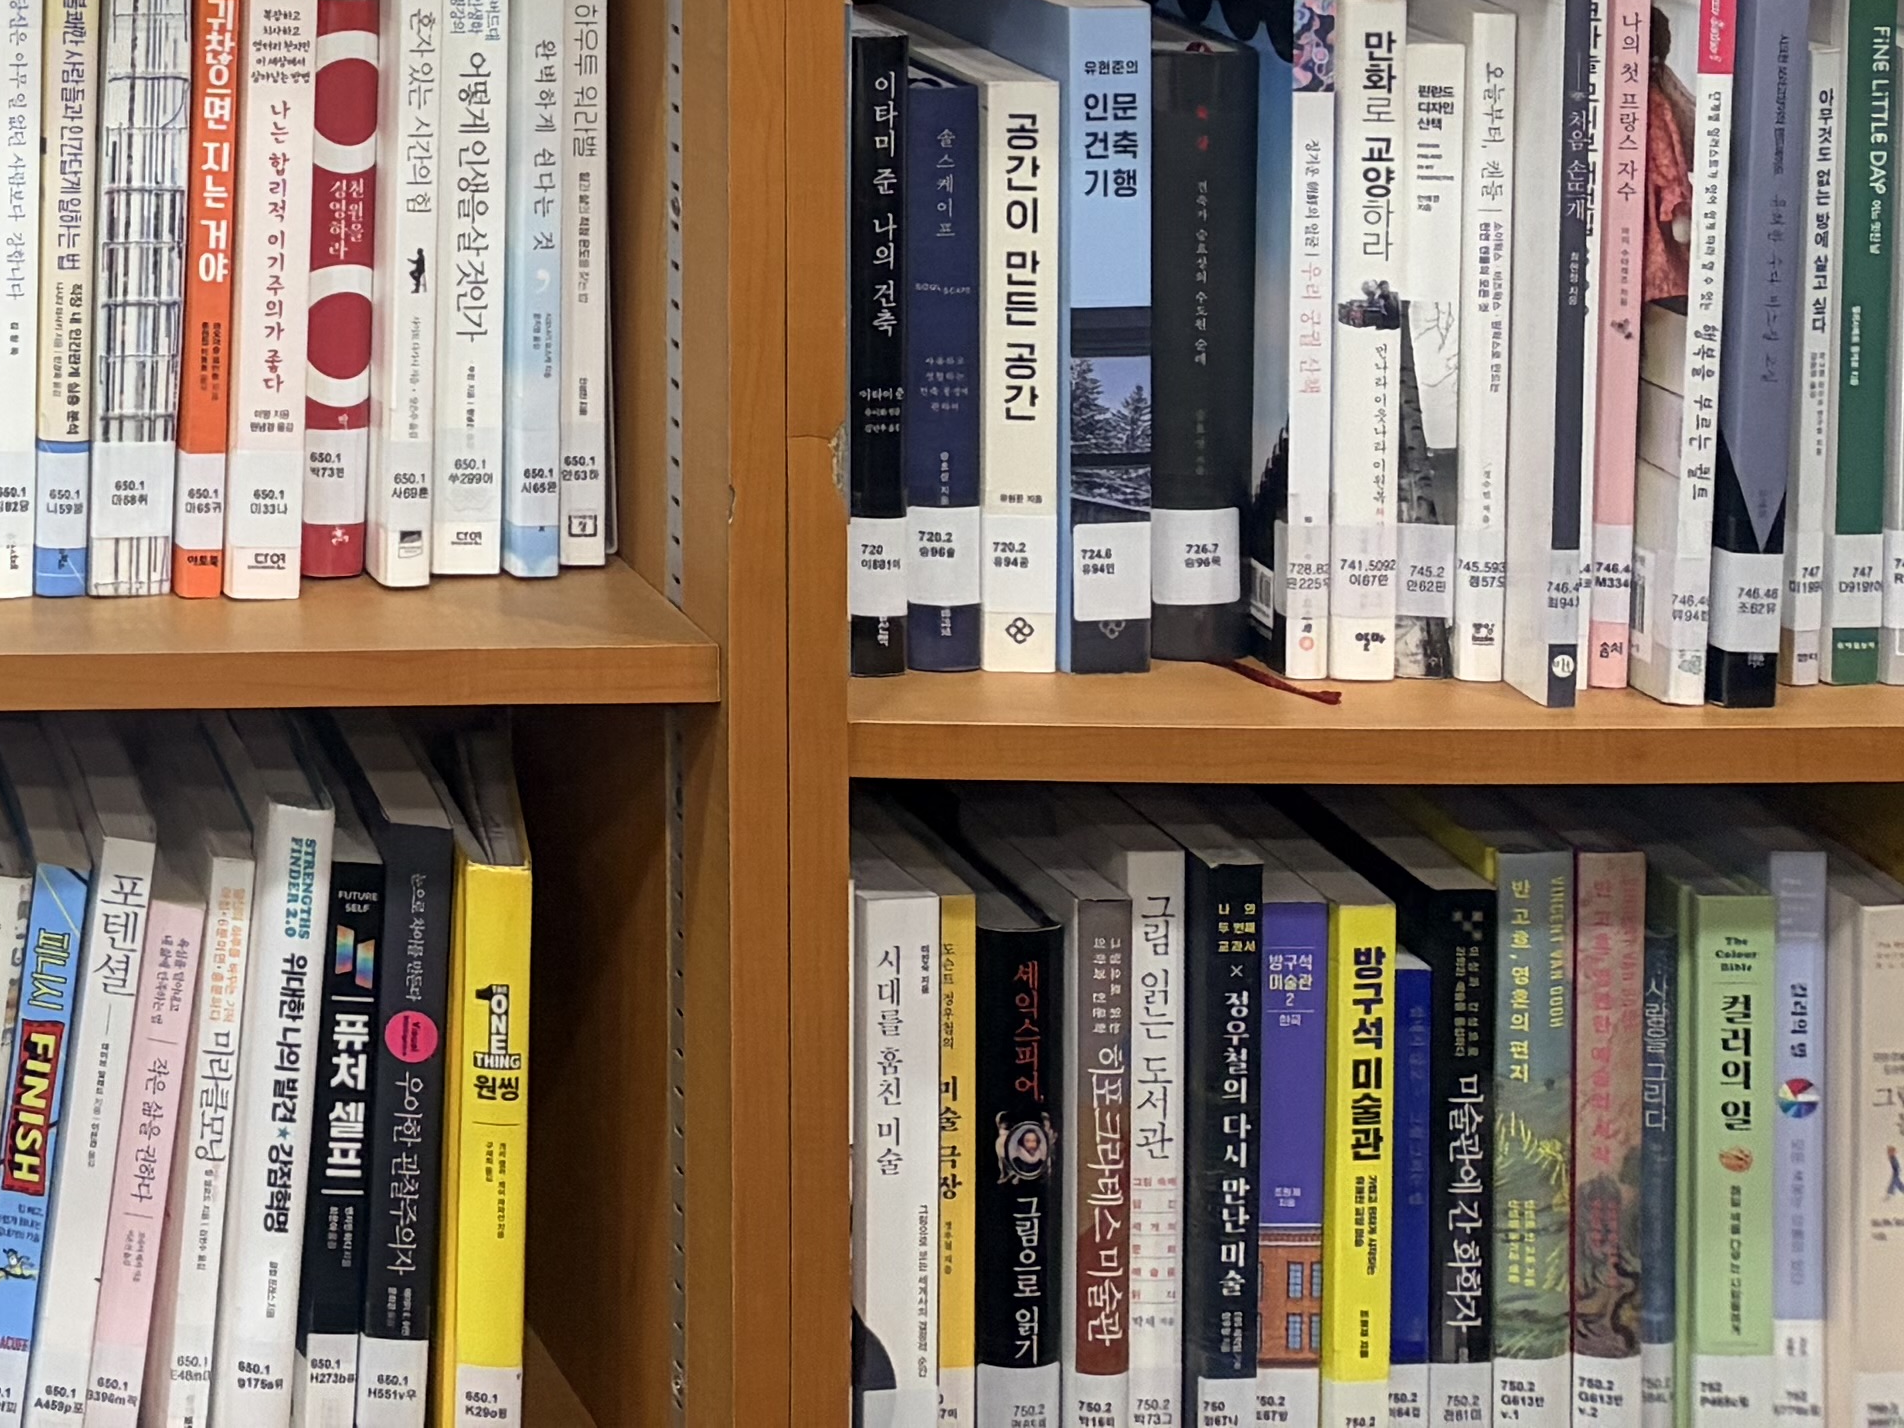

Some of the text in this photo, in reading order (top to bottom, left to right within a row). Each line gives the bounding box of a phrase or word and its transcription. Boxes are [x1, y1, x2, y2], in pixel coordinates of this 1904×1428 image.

[1085, 60, 1138, 75] 유현준의
[1084, 93, 1137, 121] 인문
[1085, 130, 1138, 159] 건축
[1085, 169, 1137, 197] 기행
[1004, 114, 1040, 420] 공간이 만든 공간
[253, 489, 284, 500] 650.1
[1351, 947, 1386, 1161] 방구석 미술관
[14, 1033, 56, 1183] FINISH
[465, 1391, 497, 1403] 650.1
